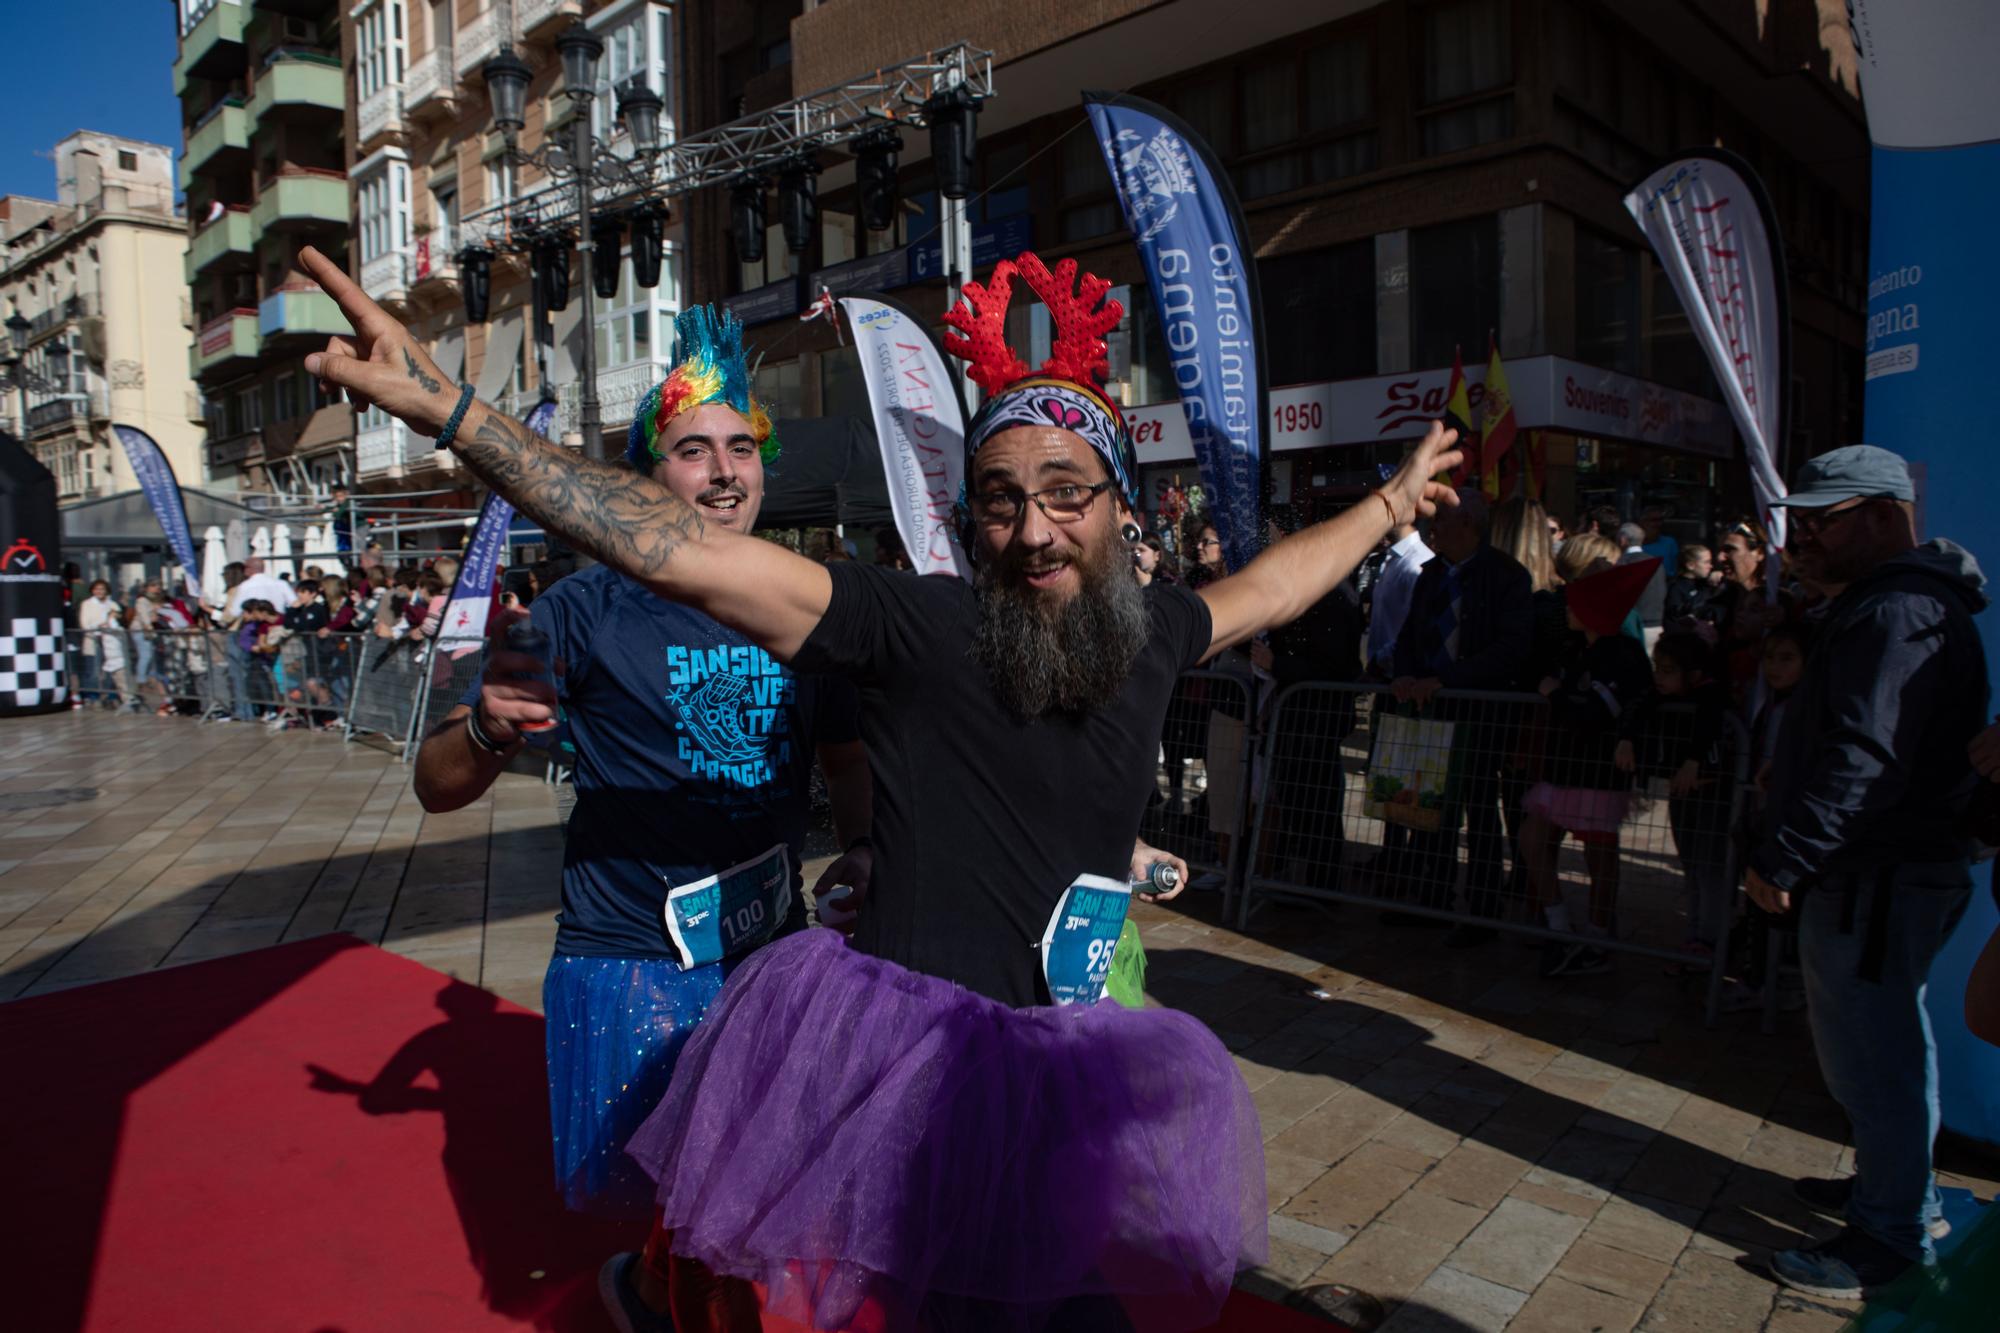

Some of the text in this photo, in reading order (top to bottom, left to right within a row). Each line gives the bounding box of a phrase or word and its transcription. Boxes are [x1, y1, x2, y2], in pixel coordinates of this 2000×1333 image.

[1565, 376, 1630, 418] Souvenirs
[1128, 413, 1164, 444] ier
[1274, 402, 1323, 433] 1950
[722, 899, 765, 939] 100
